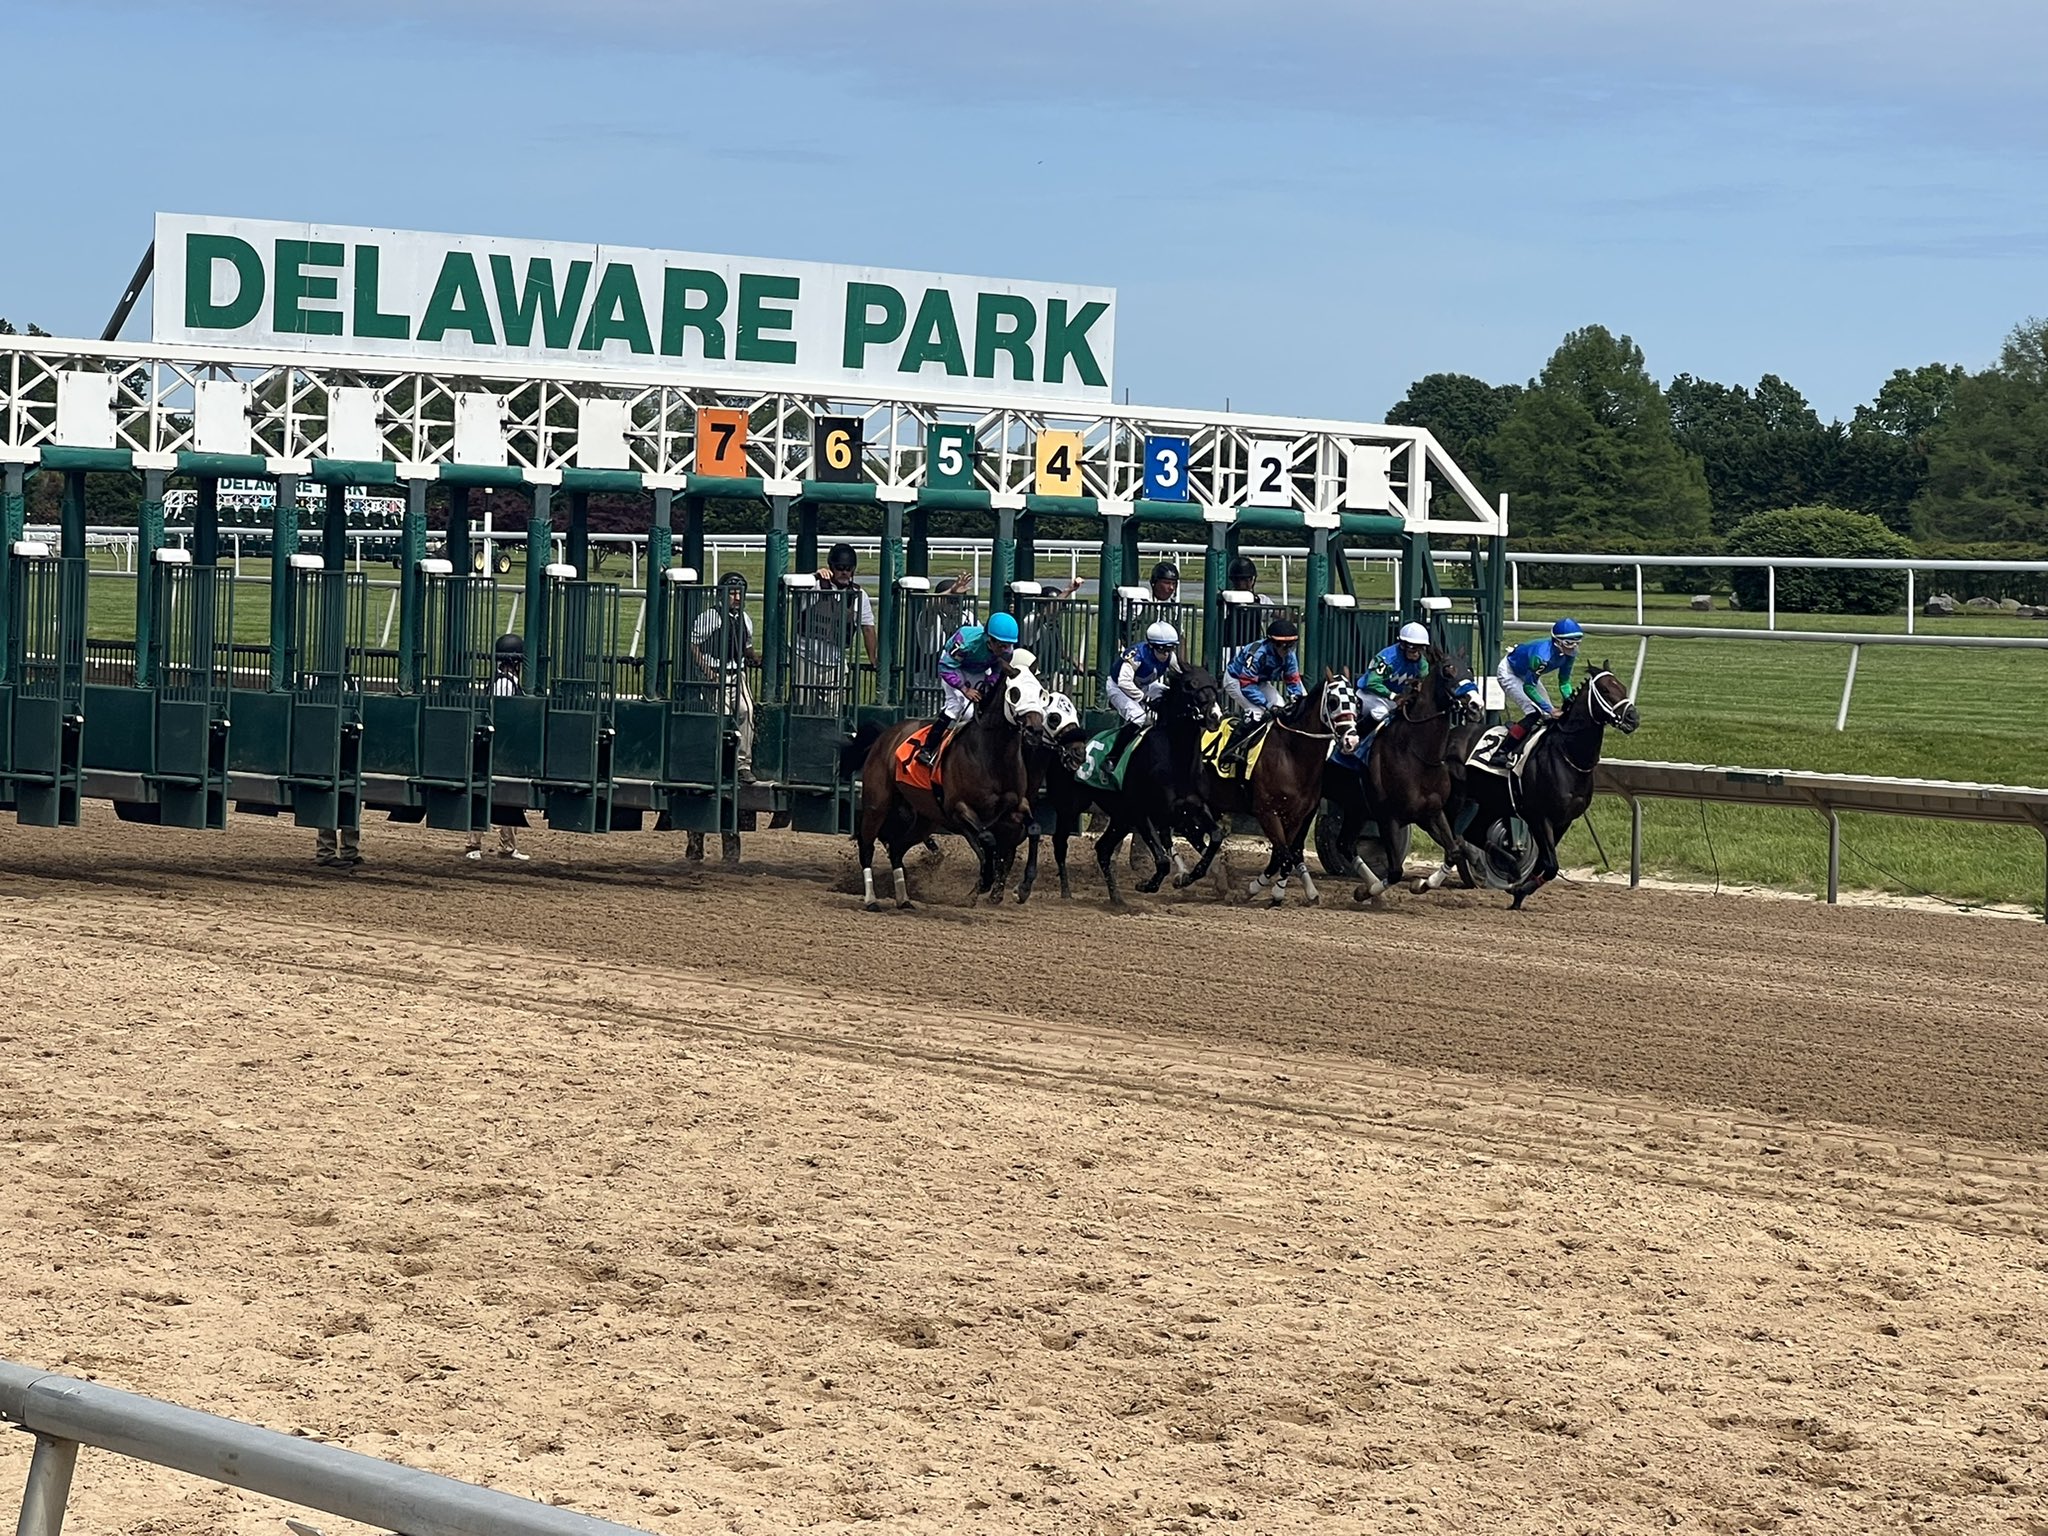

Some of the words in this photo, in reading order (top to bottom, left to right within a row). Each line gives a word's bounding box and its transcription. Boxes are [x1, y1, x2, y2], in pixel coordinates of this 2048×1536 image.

[185, 234, 800, 364] DELAWARE
[843, 283, 1107, 386] PARK
[710, 423, 736, 461] 7
[825, 430, 852, 470] 6
[937, 437, 963, 476] 5
[1045, 445, 1071, 482] 4
[1155, 449, 1179, 488] 3
[1259, 457, 1282, 492] 2
[950, 642, 961, 655] 7
[1245, 655, 1254, 669] 4
[1375, 661, 1387, 675] 3
[1535, 664, 1546, 676] 2
[900, 737, 922, 776] 7
[1076, 739, 1105, 781] 5
[1201, 731, 1223, 763] 4
[1471, 733, 1501, 767] 2
